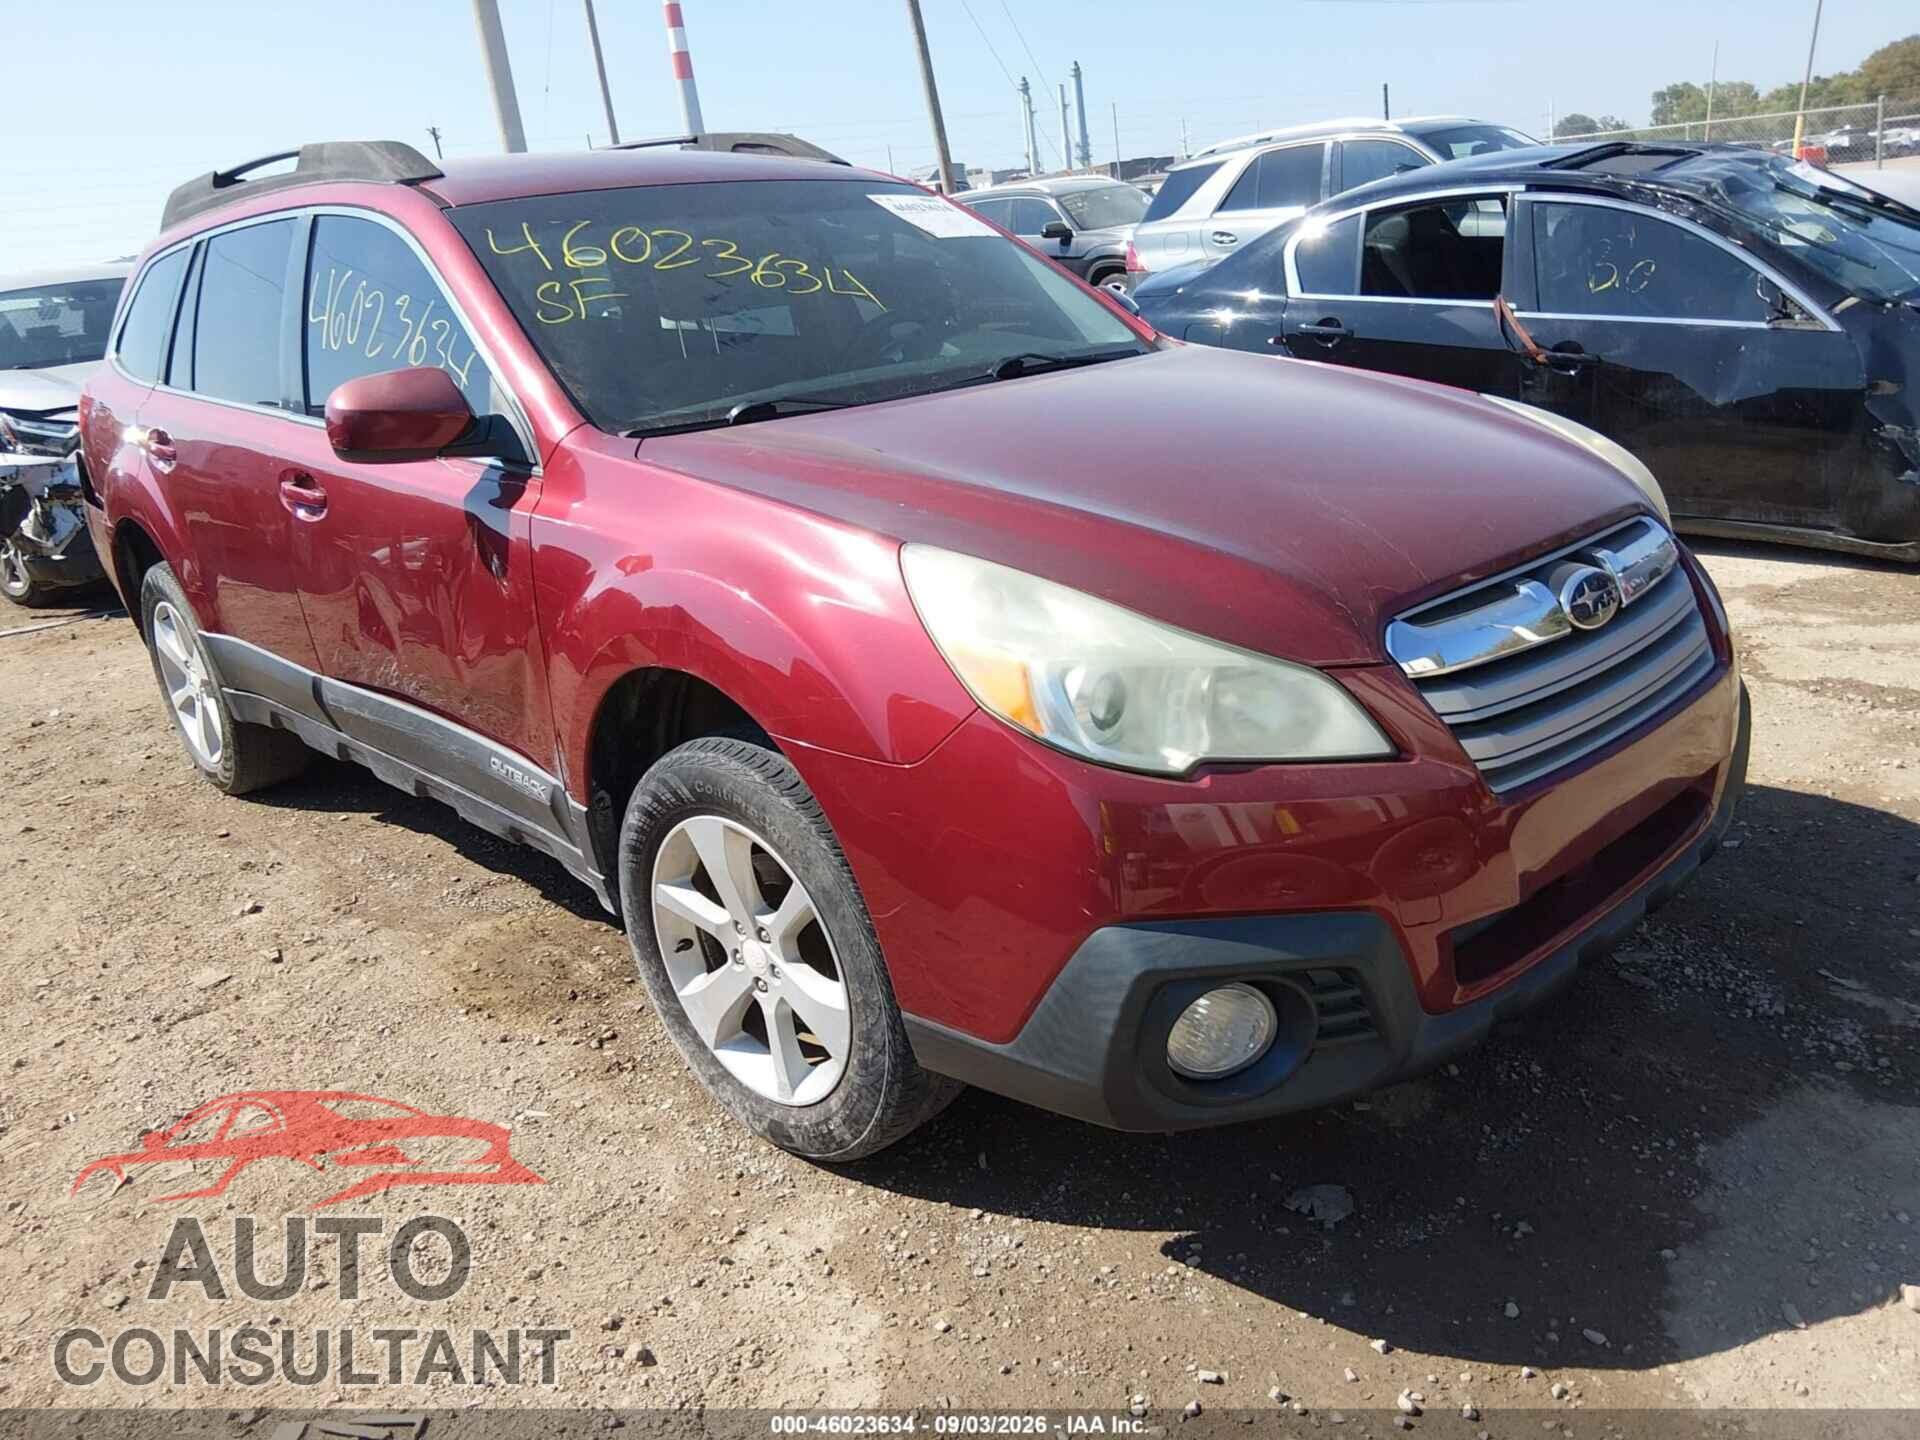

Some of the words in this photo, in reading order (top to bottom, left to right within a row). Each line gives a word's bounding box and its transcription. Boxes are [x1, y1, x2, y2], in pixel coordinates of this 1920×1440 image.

[486, 220, 887, 313] 46023634
[536, 277, 629, 325] SF
[490, 756, 548, 801] OUTBACK
